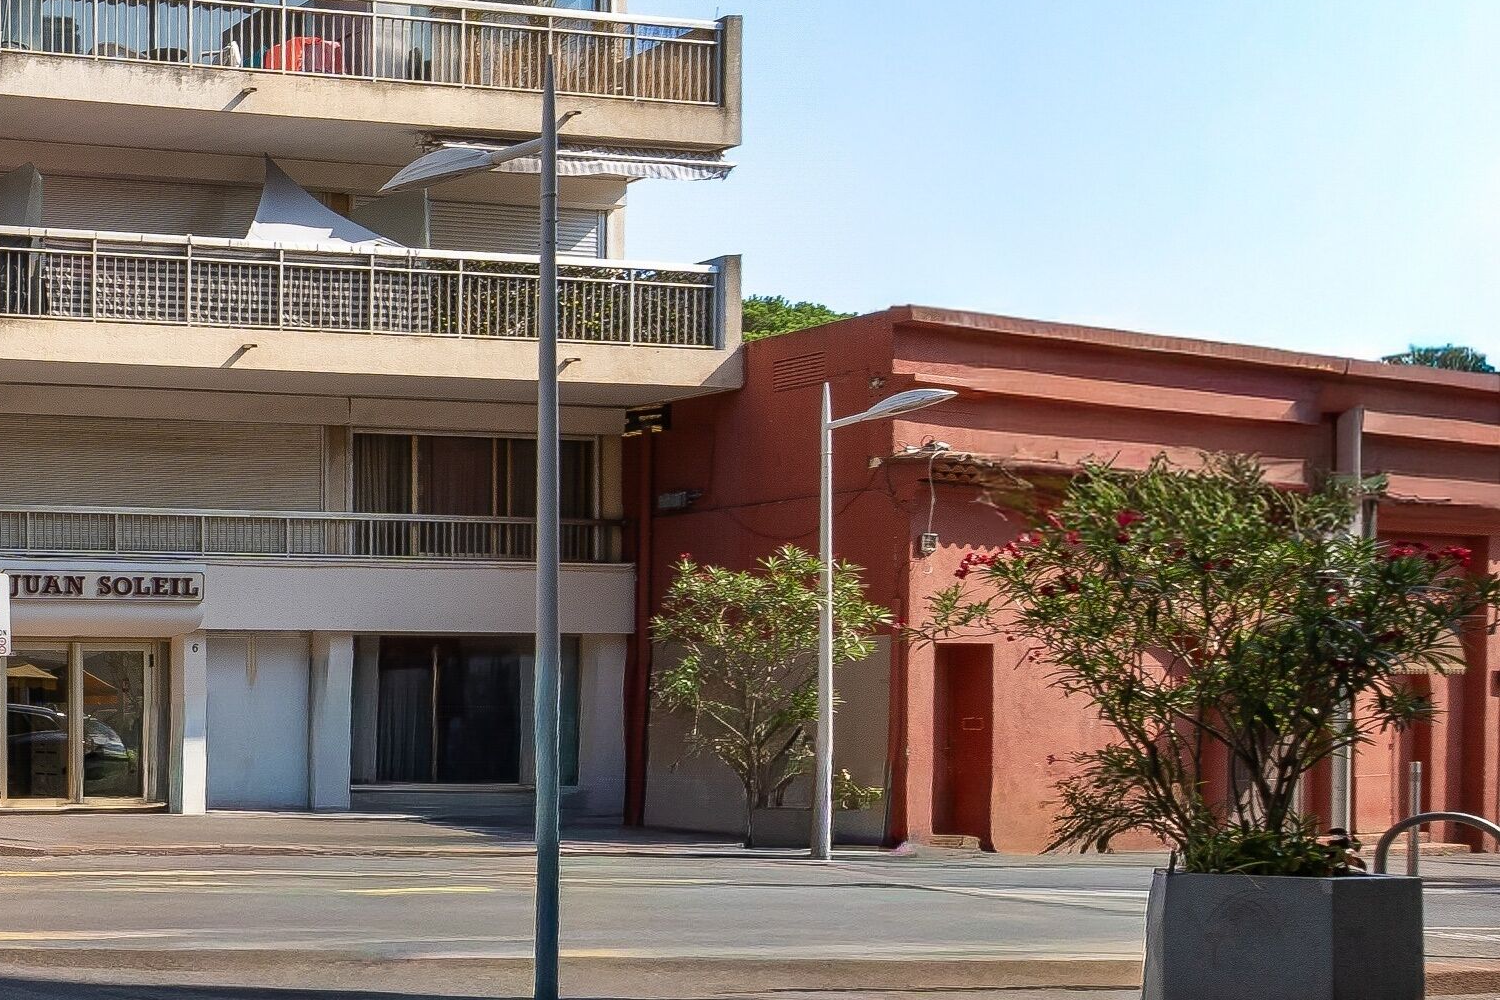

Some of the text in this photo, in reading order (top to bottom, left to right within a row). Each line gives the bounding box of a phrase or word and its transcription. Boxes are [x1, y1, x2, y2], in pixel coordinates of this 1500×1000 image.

[9, 574, 199, 597] JUAN SOLEIL
[192, 643, 199, 653] 6
